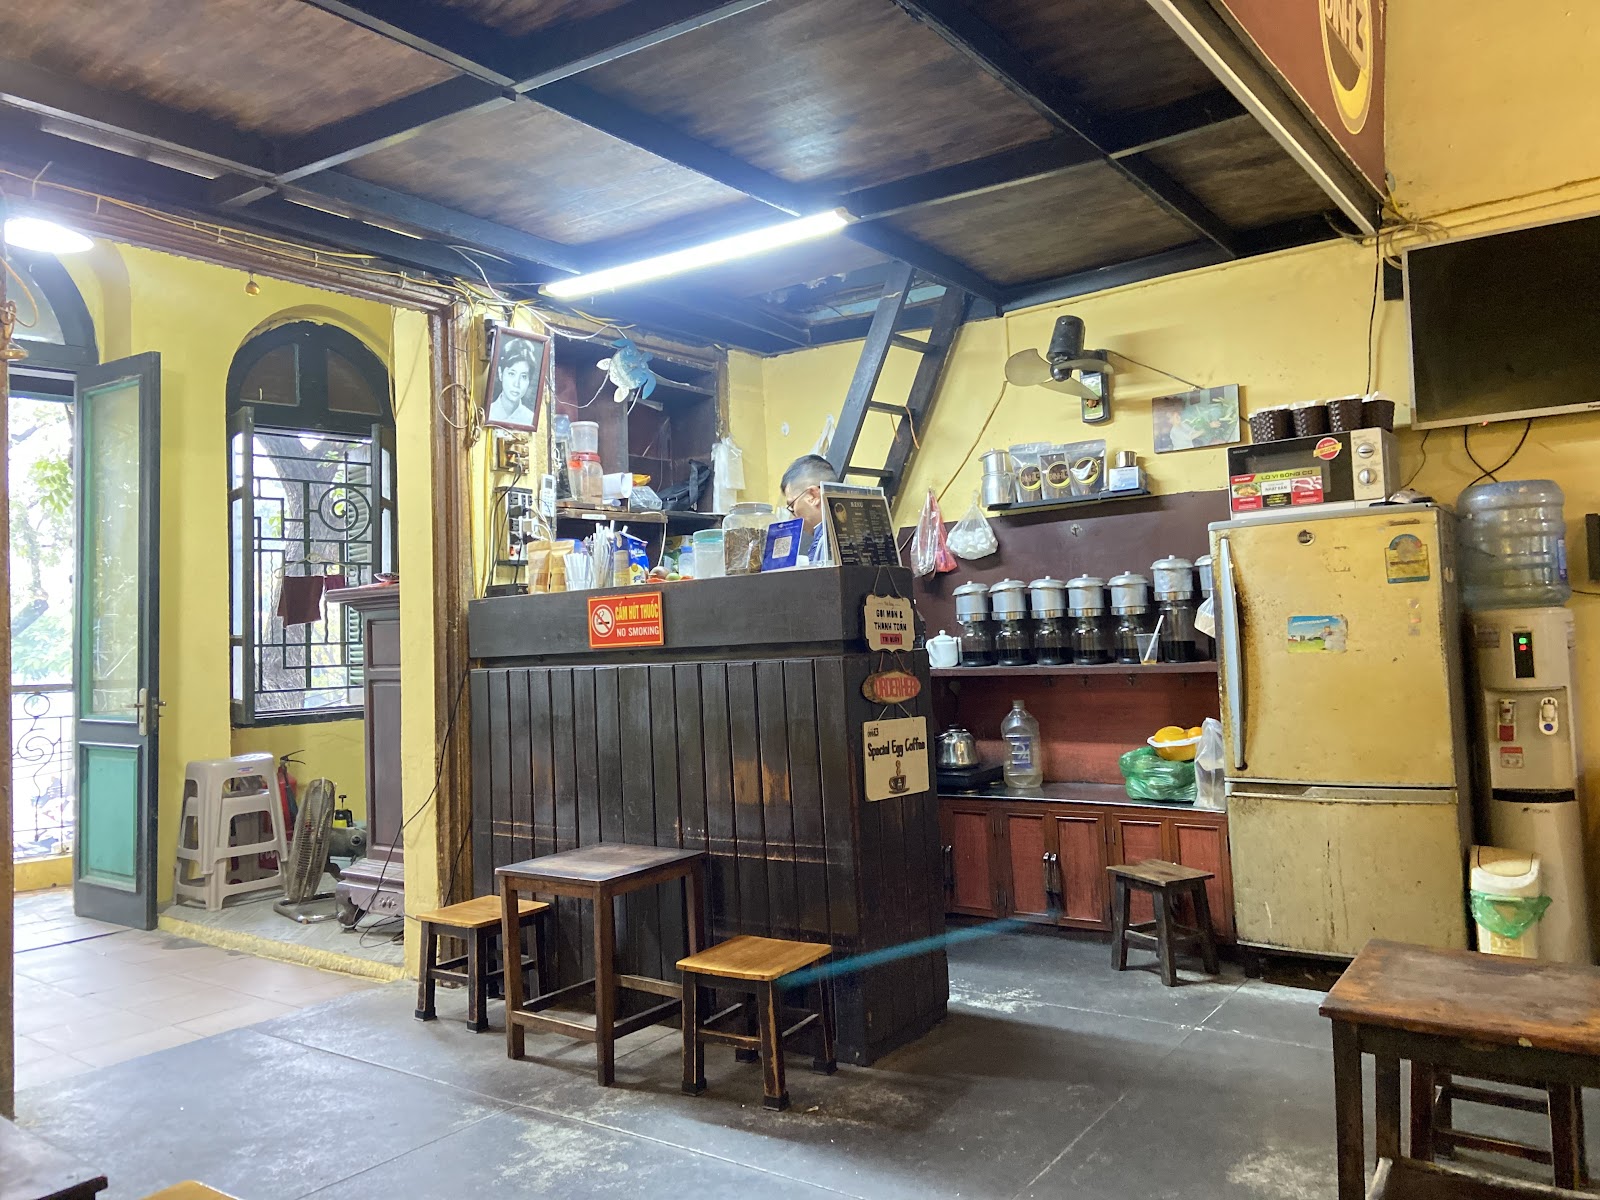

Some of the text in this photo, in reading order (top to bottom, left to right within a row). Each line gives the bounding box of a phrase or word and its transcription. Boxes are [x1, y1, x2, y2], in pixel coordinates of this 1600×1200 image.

[615, 598, 659, 620] CẤM HÚT THUỐC
[616, 626, 660, 637] NO SMOKING
[868, 737, 926, 761] Special Egg Coffee
